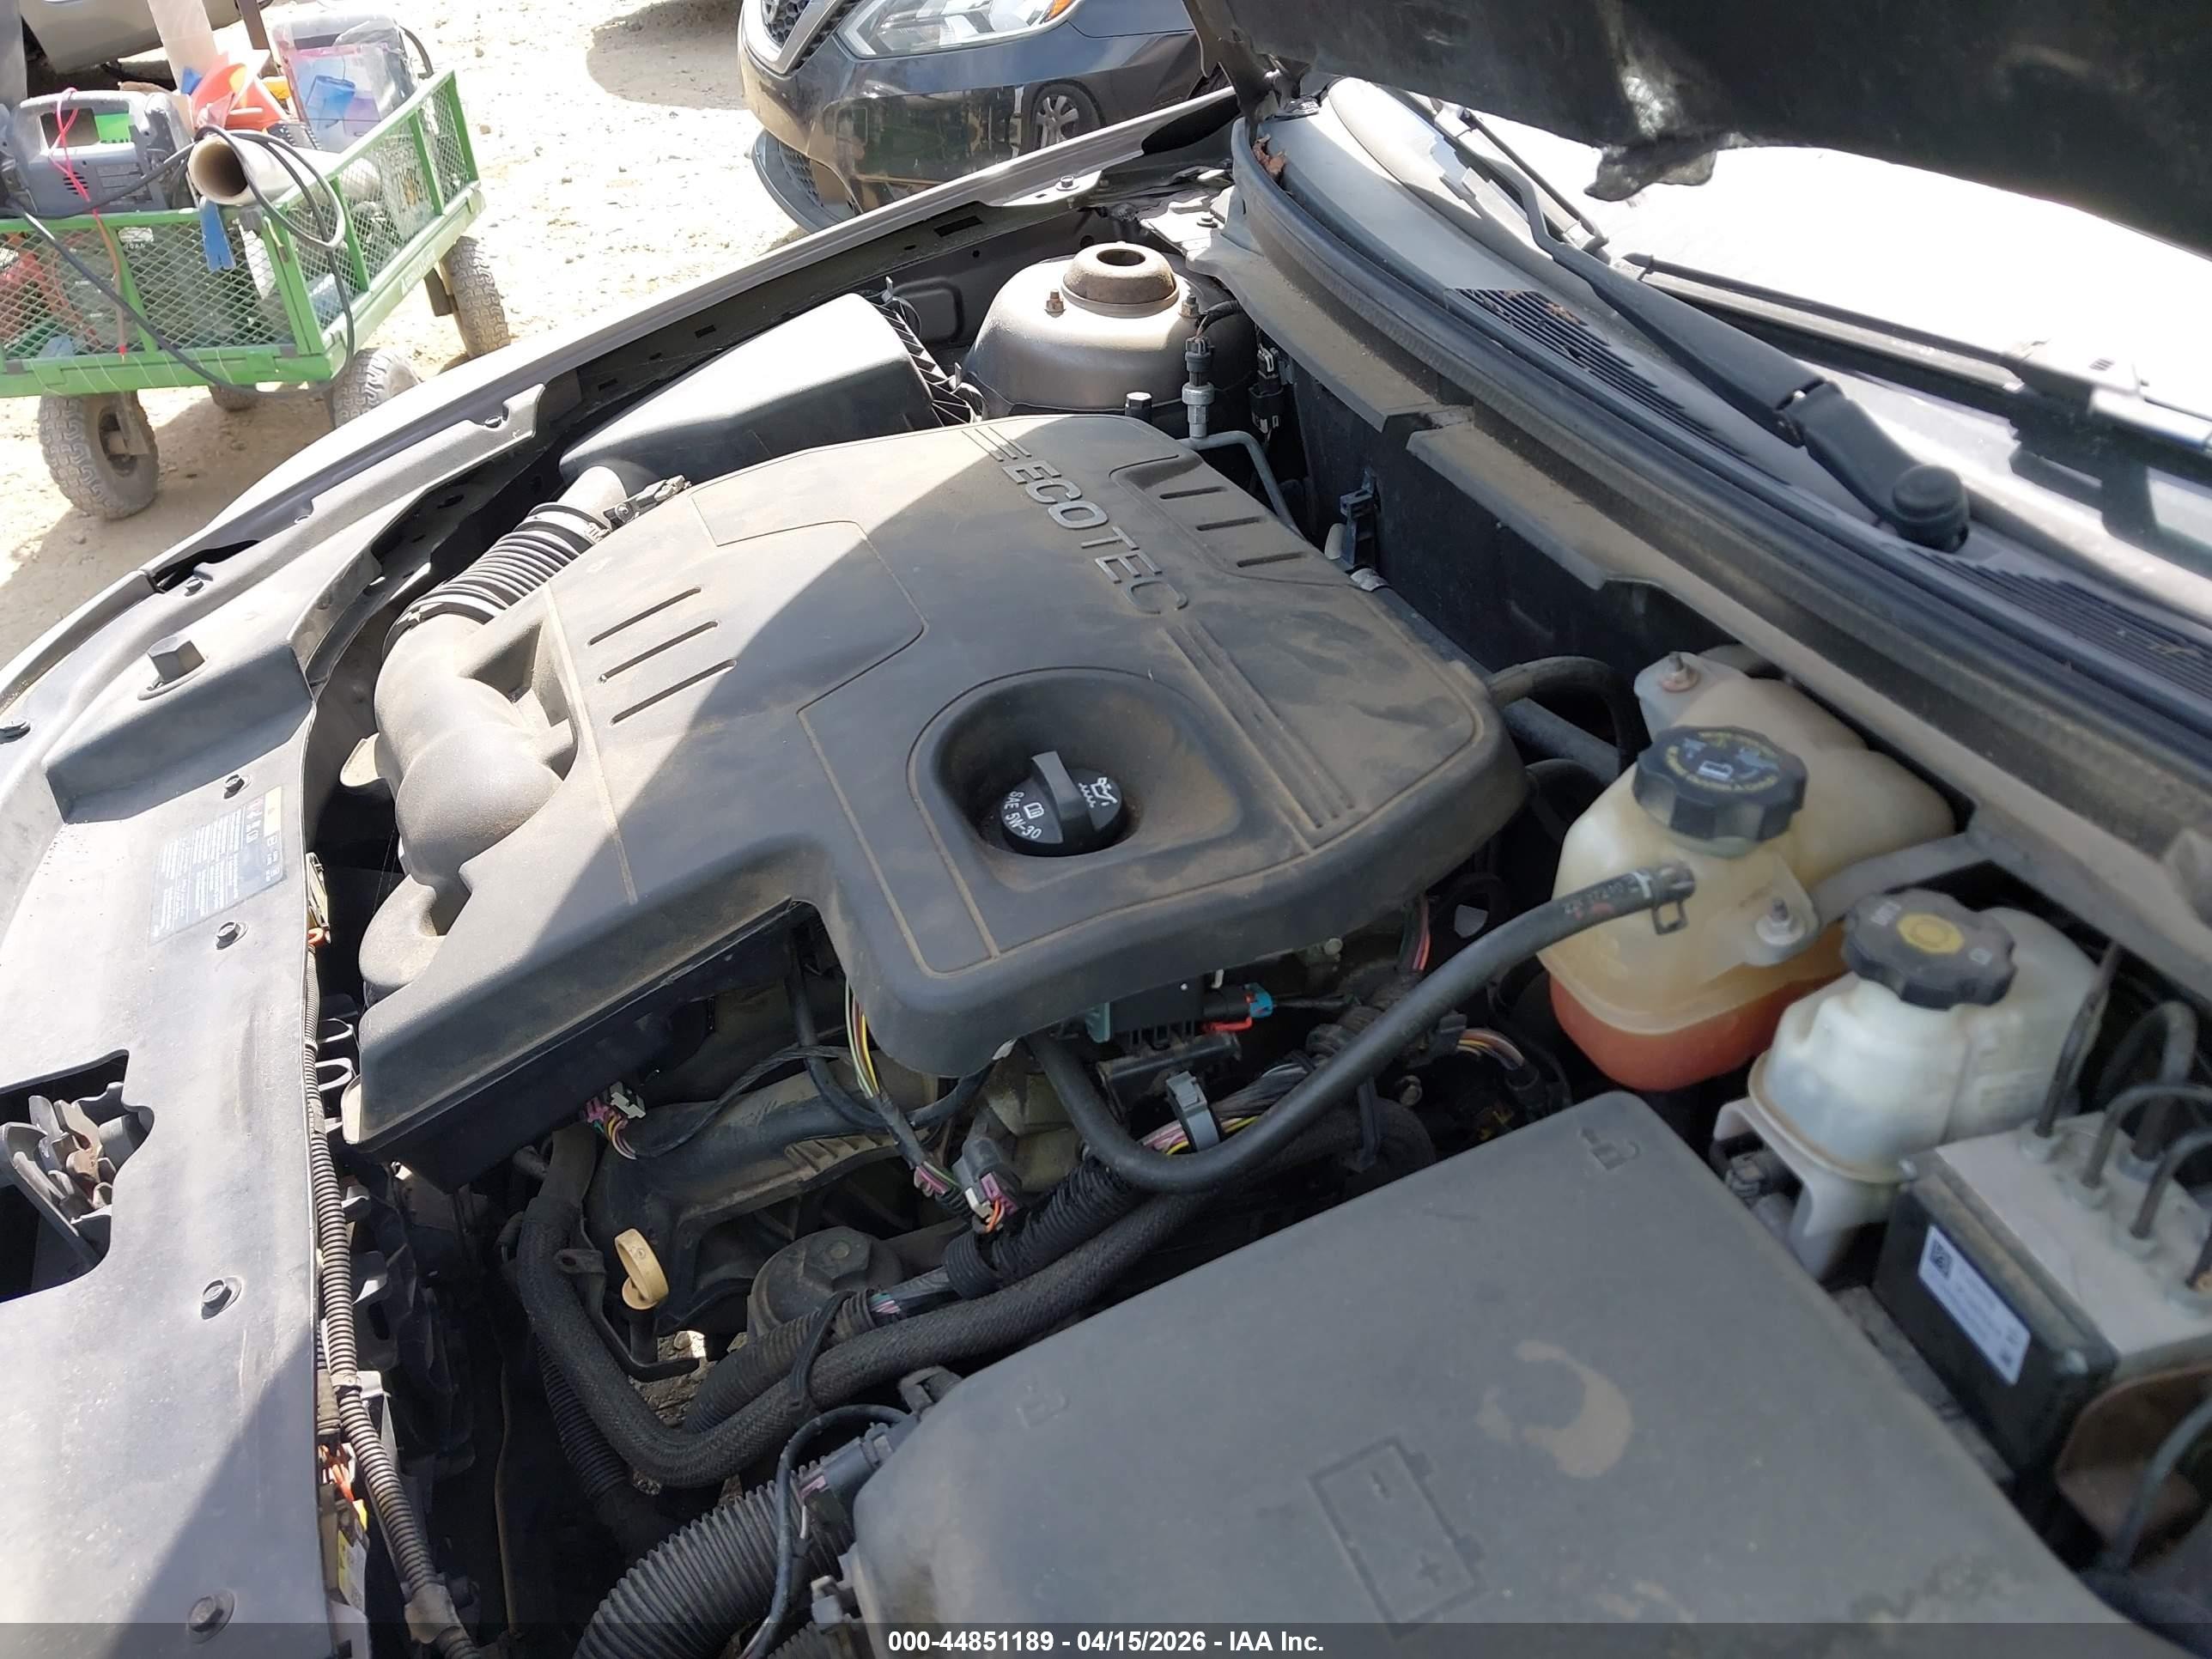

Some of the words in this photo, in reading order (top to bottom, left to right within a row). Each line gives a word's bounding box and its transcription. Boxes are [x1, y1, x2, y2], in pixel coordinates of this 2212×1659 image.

[1001, 459, 1189, 615] ECOTEC
[1003, 790, 1025, 811] SAE
[1005, 811, 1042, 839] 5W-30
